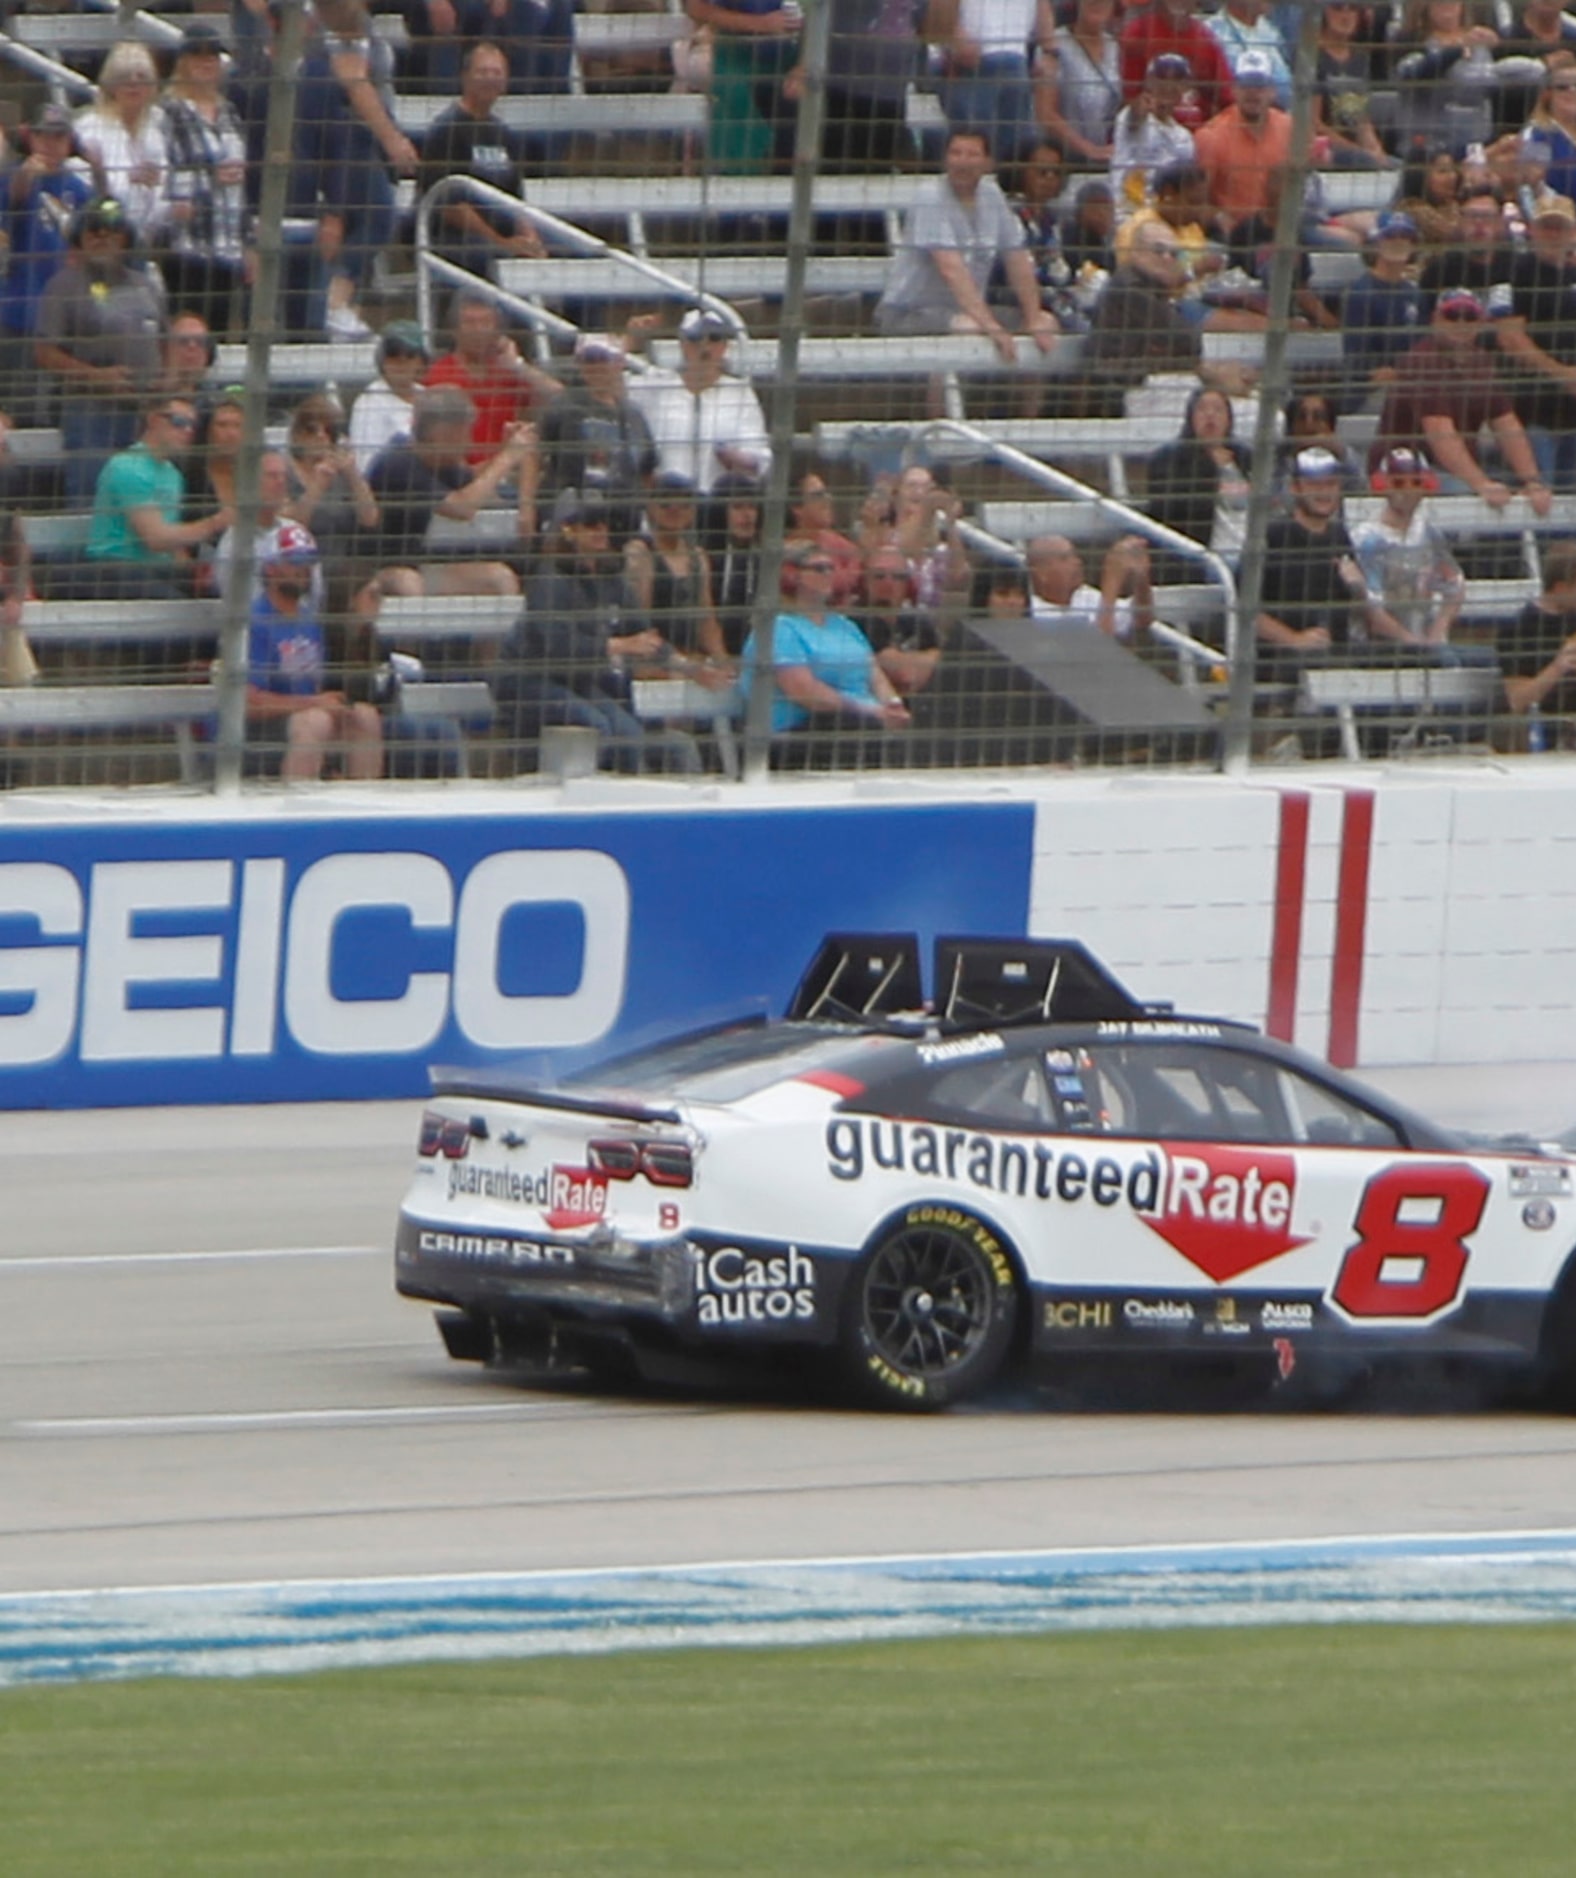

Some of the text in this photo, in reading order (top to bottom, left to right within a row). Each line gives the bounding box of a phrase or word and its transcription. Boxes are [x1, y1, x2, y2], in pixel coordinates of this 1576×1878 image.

[448, 1162, 606, 1214] guaranteed Rate
[826, 1119, 1292, 1230] guaranteed Rate
[659, 1202, 680, 1231] 8
[1332, 1162, 1492, 1320] 8
[698, 1288, 816, 1324] autos
